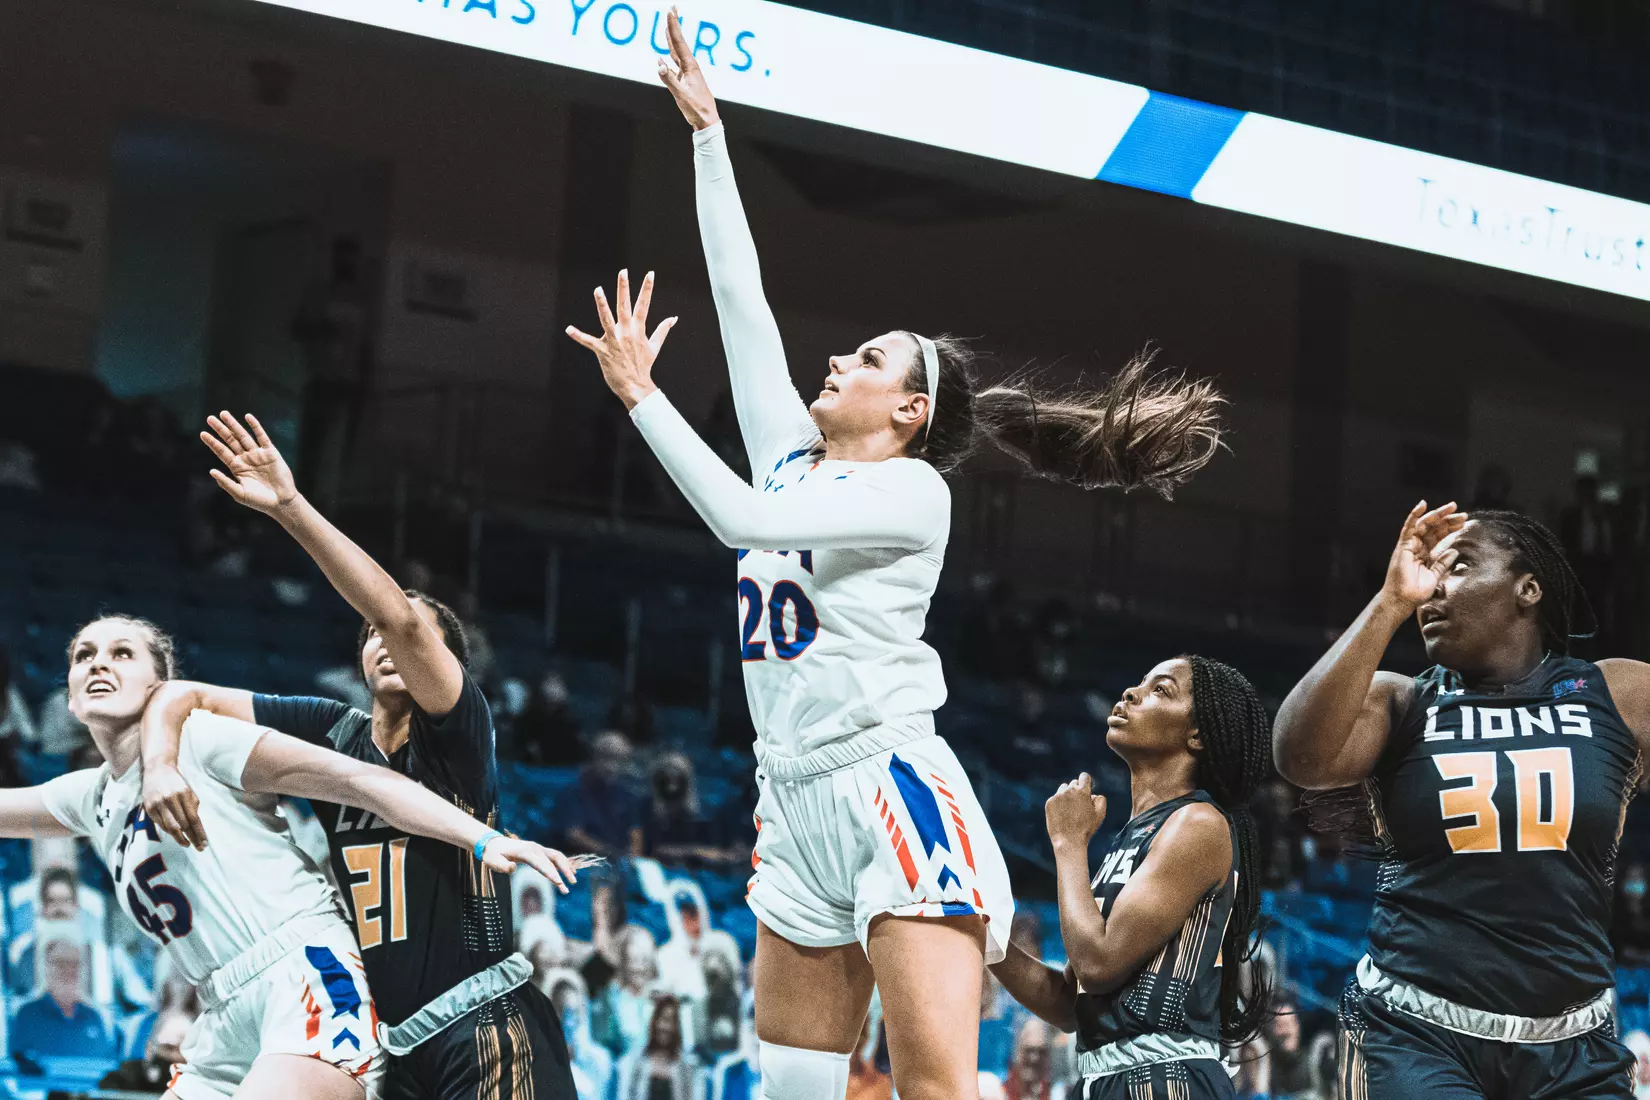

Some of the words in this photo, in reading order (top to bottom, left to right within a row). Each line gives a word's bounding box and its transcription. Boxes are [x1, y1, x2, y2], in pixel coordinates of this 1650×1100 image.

[570, 0, 771, 77] YOURS.
[738, 576, 820, 663] 20
[1423, 703, 1593, 742] LIONS
[1431, 746, 1575, 854] 30
[126, 852, 193, 945] 45
[342, 836, 411, 950] 21
